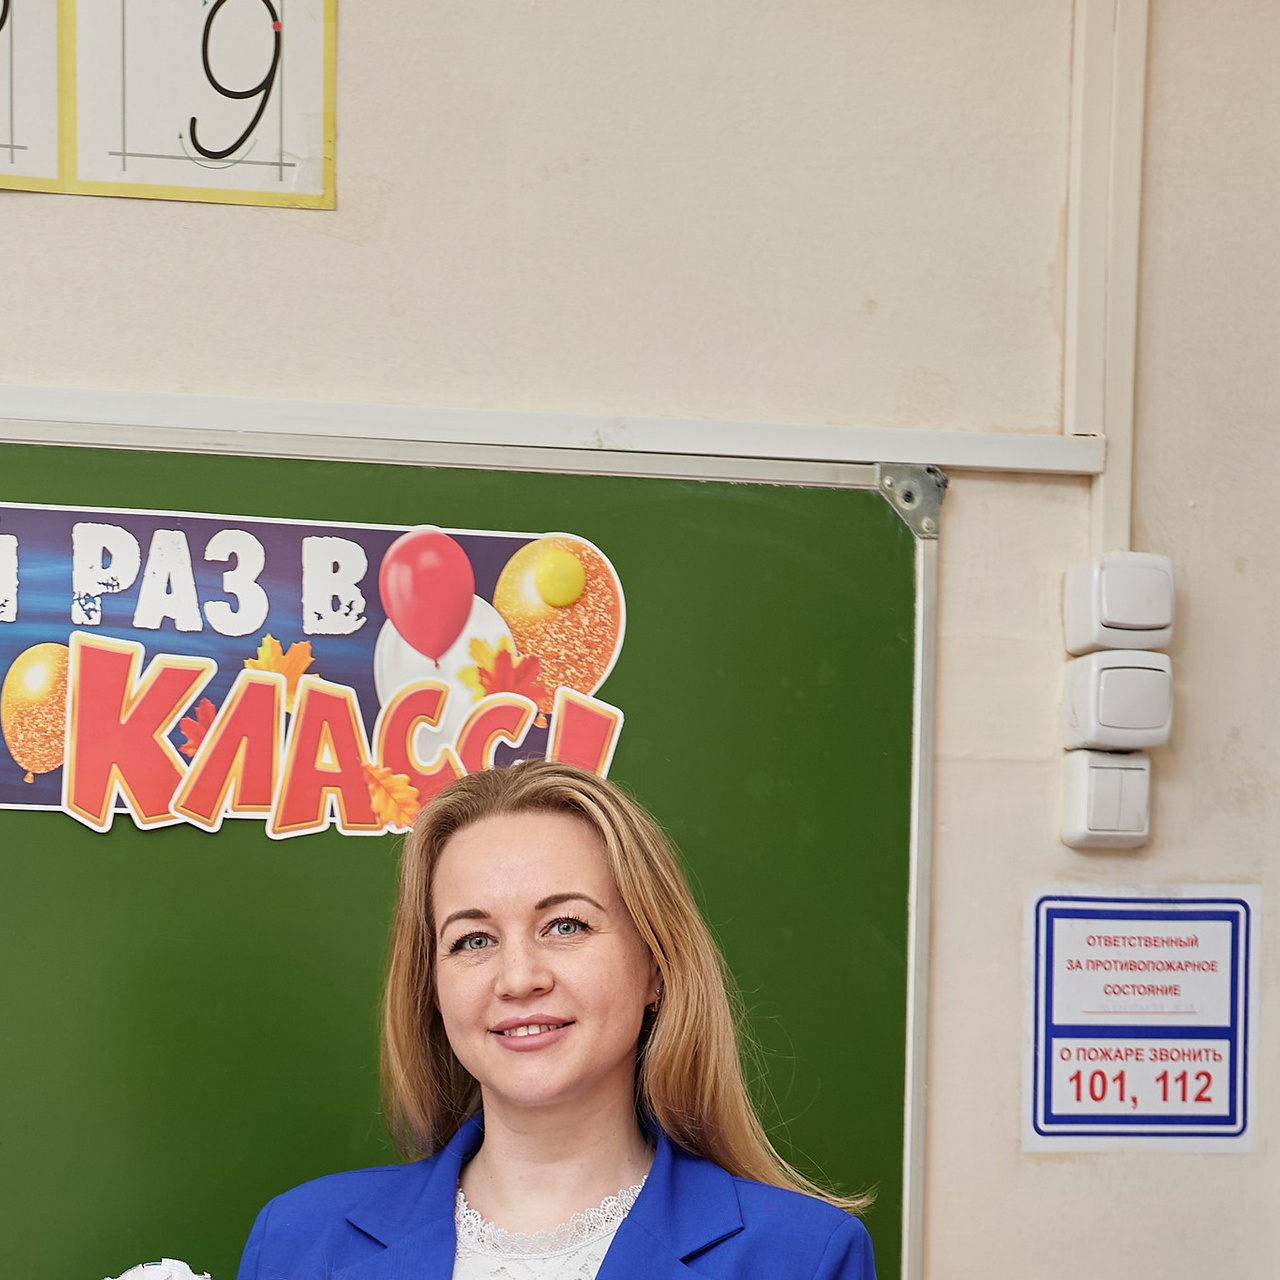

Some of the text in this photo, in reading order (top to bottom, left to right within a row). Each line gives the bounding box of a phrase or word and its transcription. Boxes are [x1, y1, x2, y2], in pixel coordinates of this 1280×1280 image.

[188, 0, 281, 159] 9
[70, 521, 270, 637] РАЗ
[301, 535, 370, 636] В
[1086, 934, 1199, 948] ОТВЕТСТВЕННЫЙ
[1066, 959, 1219, 973] ЗА ПРОТИВОПОЖАРНОЕ
[1103, 984, 1181, 996] СОСТОЯНИЕ
[1059, 1047, 1223, 1063] О ПОЖАРЕ ЗВОНИТЬ
[1068, 1069, 1213, 1110] 101, 112
